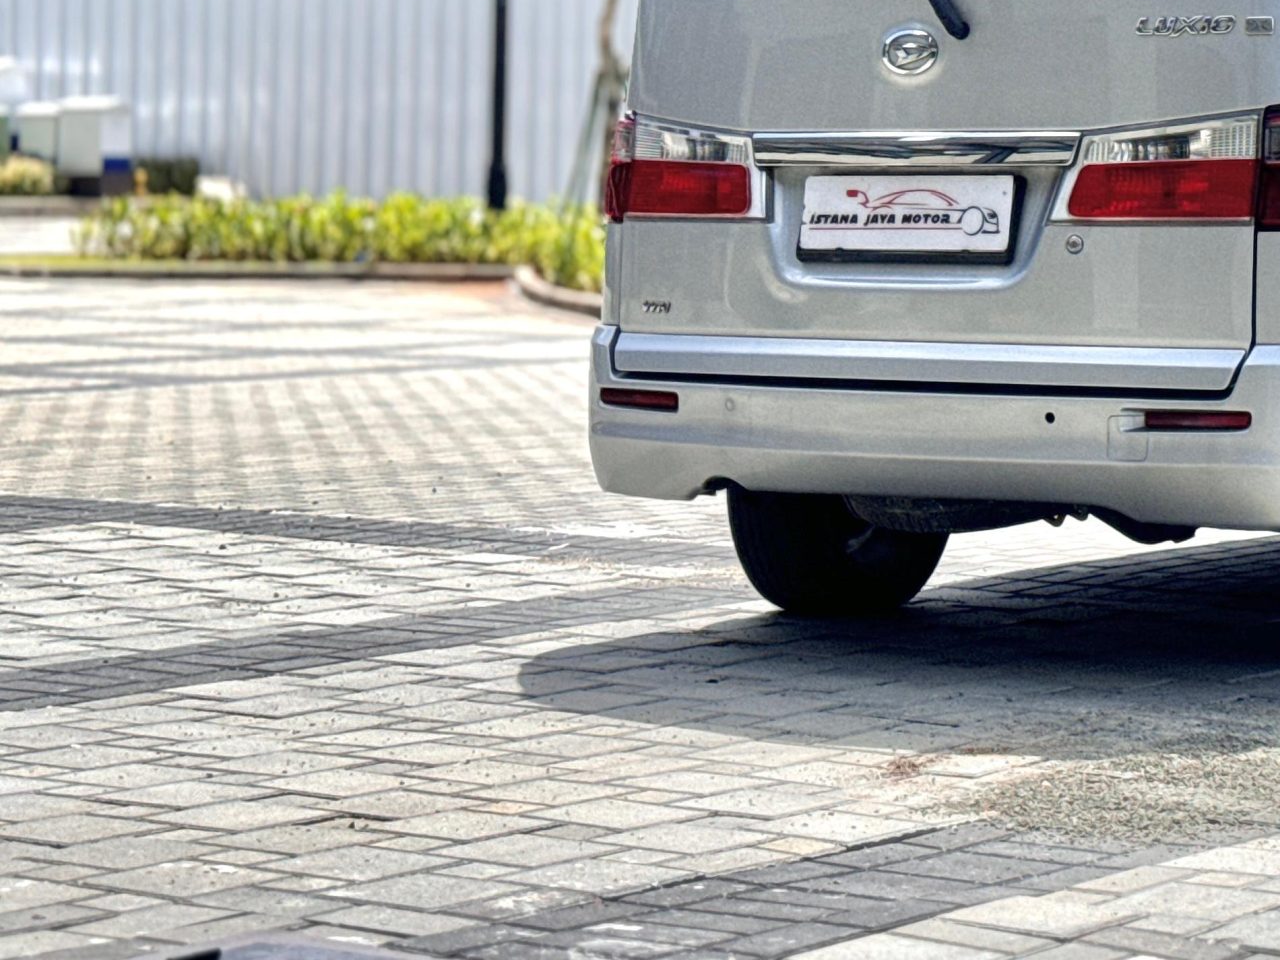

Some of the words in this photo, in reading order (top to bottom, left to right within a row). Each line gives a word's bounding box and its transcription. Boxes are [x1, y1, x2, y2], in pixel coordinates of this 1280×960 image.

[809, 212, 858, 225] ISTANA
[863, 212, 896, 226] JAYA
[901, 213, 950, 225] MOTOR
